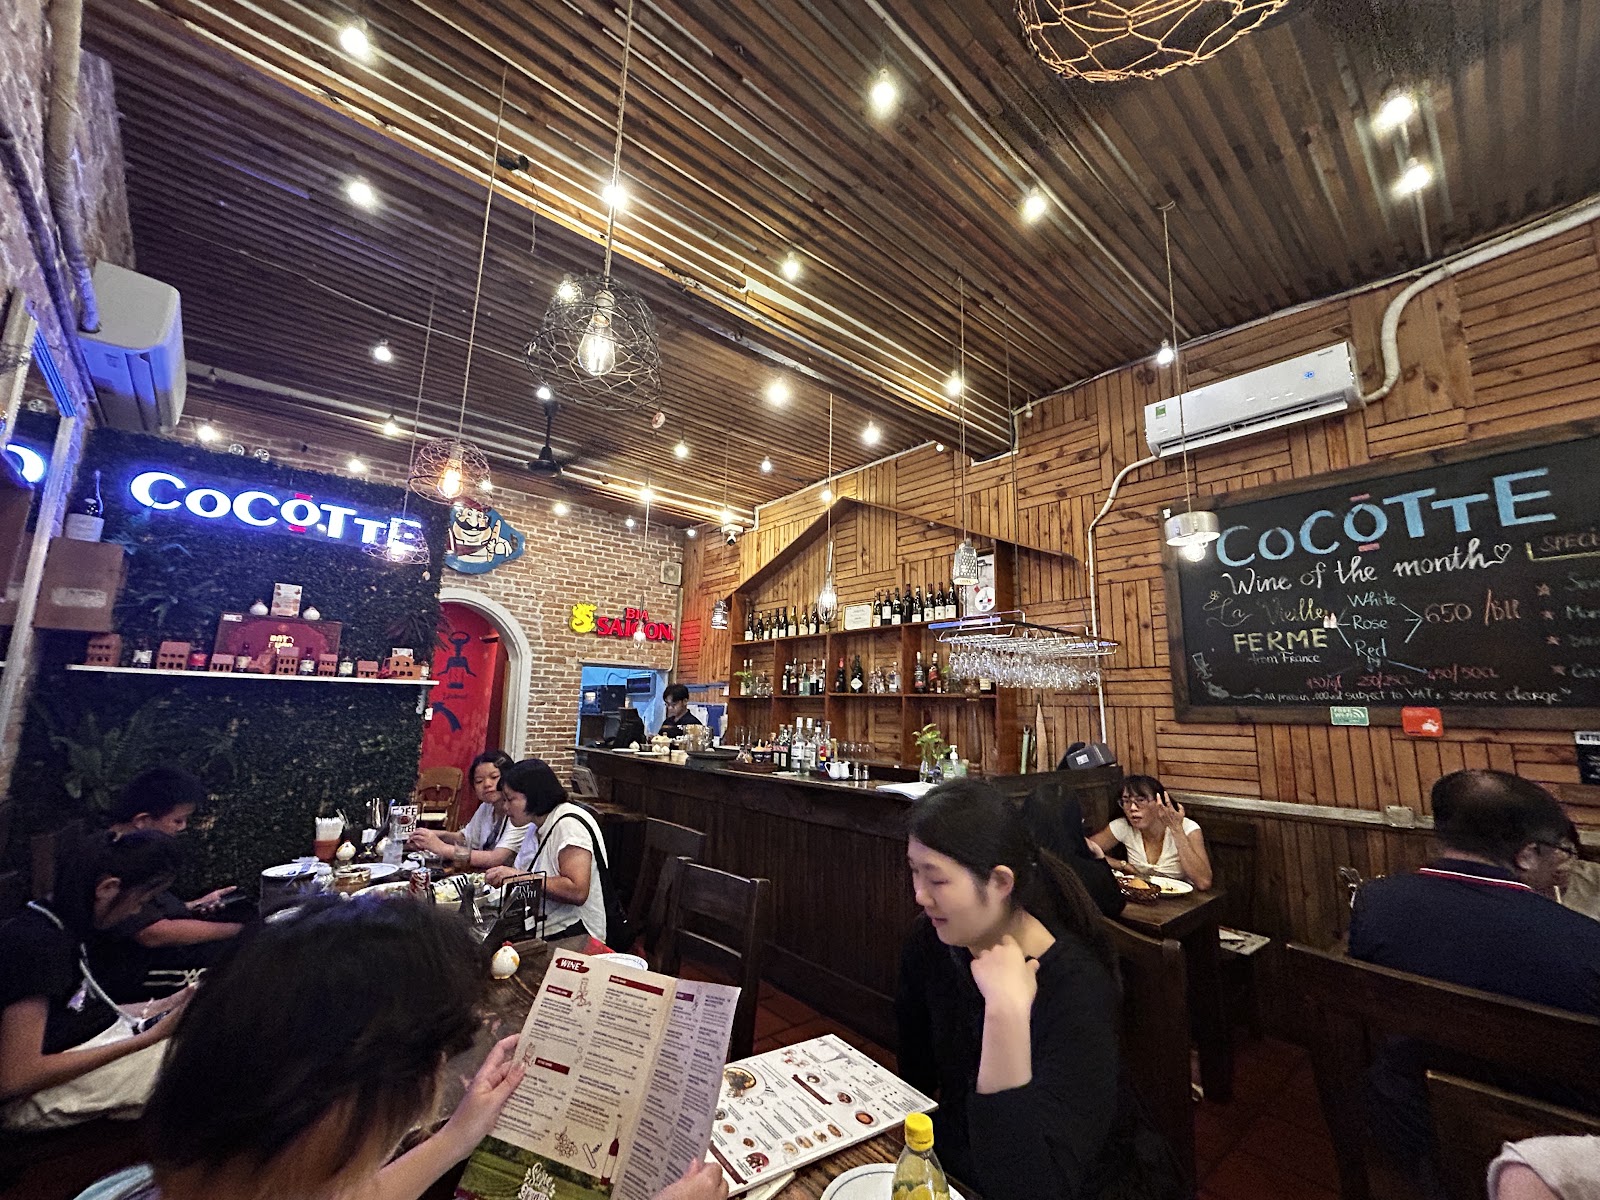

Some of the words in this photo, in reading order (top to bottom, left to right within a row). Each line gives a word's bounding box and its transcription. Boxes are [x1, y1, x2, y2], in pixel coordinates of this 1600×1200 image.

[1221, 567, 1293, 596] Wine
[1300, 562, 1327, 589] of
[1334, 556, 1378, 585] the
[1392, 537, 1494, 578] month
[1347, 592, 1397, 607] White
[624, 607, 650, 621] BIA
[1425, 603, 1473, 624] 650
[1233, 627, 1328, 654] FERME
[1354, 637, 1388, 658] Red
[1281, 650, 1321, 664] France
[560, 958, 582, 971] WINE
